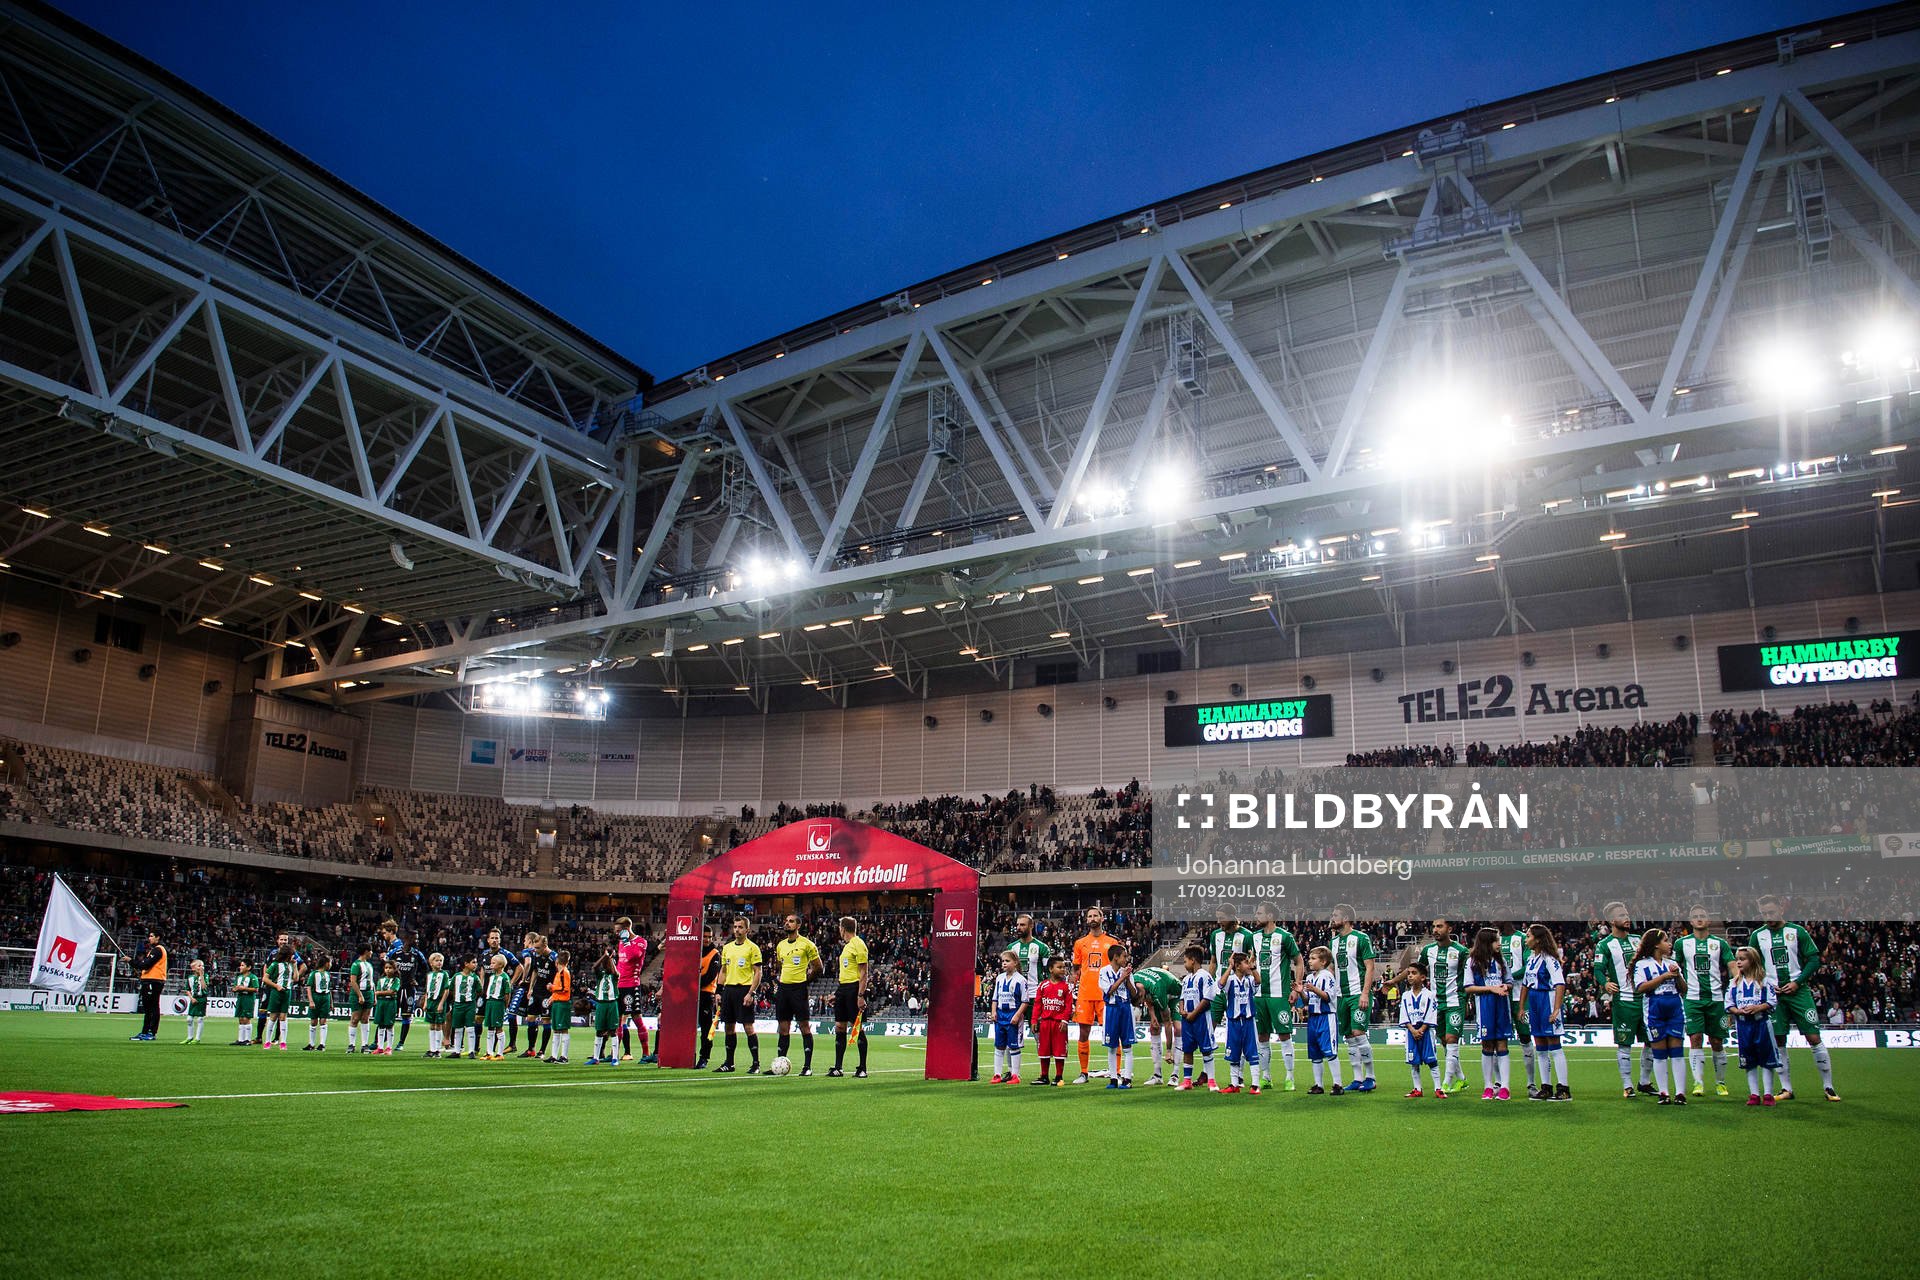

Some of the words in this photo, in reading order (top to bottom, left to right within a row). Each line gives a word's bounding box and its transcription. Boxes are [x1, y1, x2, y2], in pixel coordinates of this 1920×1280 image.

[1761, 637, 1900, 666] HAMMARBY
[1770, 656, 1897, 685] GÖTEBORG
[1398, 675, 1515, 723] TELE2
[1525, 683, 1648, 715] Arena
[1198, 701, 1308, 724] HAMMARBY
[1203, 718, 1303, 741] GÖTEBORG
[265, 733, 307, 752] TELE2
[308, 741, 347, 761] Arena
[795, 853, 824, 861] SVENSKA
[825, 852, 841, 860] SPEL
[1473, 855, 1517, 866] FOTBOLL
[1522, 852, 1595, 864] GEMENSKAP
[1605, 849, 1659, 861] RESPEKT
[1669, 846, 1718, 857] KÄRLEK
[731, 869, 780, 888] Framåt
[781, 869, 804, 887] för
[804, 866, 851, 886] svensk
[853, 864, 908, 884] fotboll!
[65, 973, 82, 982] SPEL
[885, 1023, 925, 1036] BST
[1562, 1030, 1598, 1045] ST
